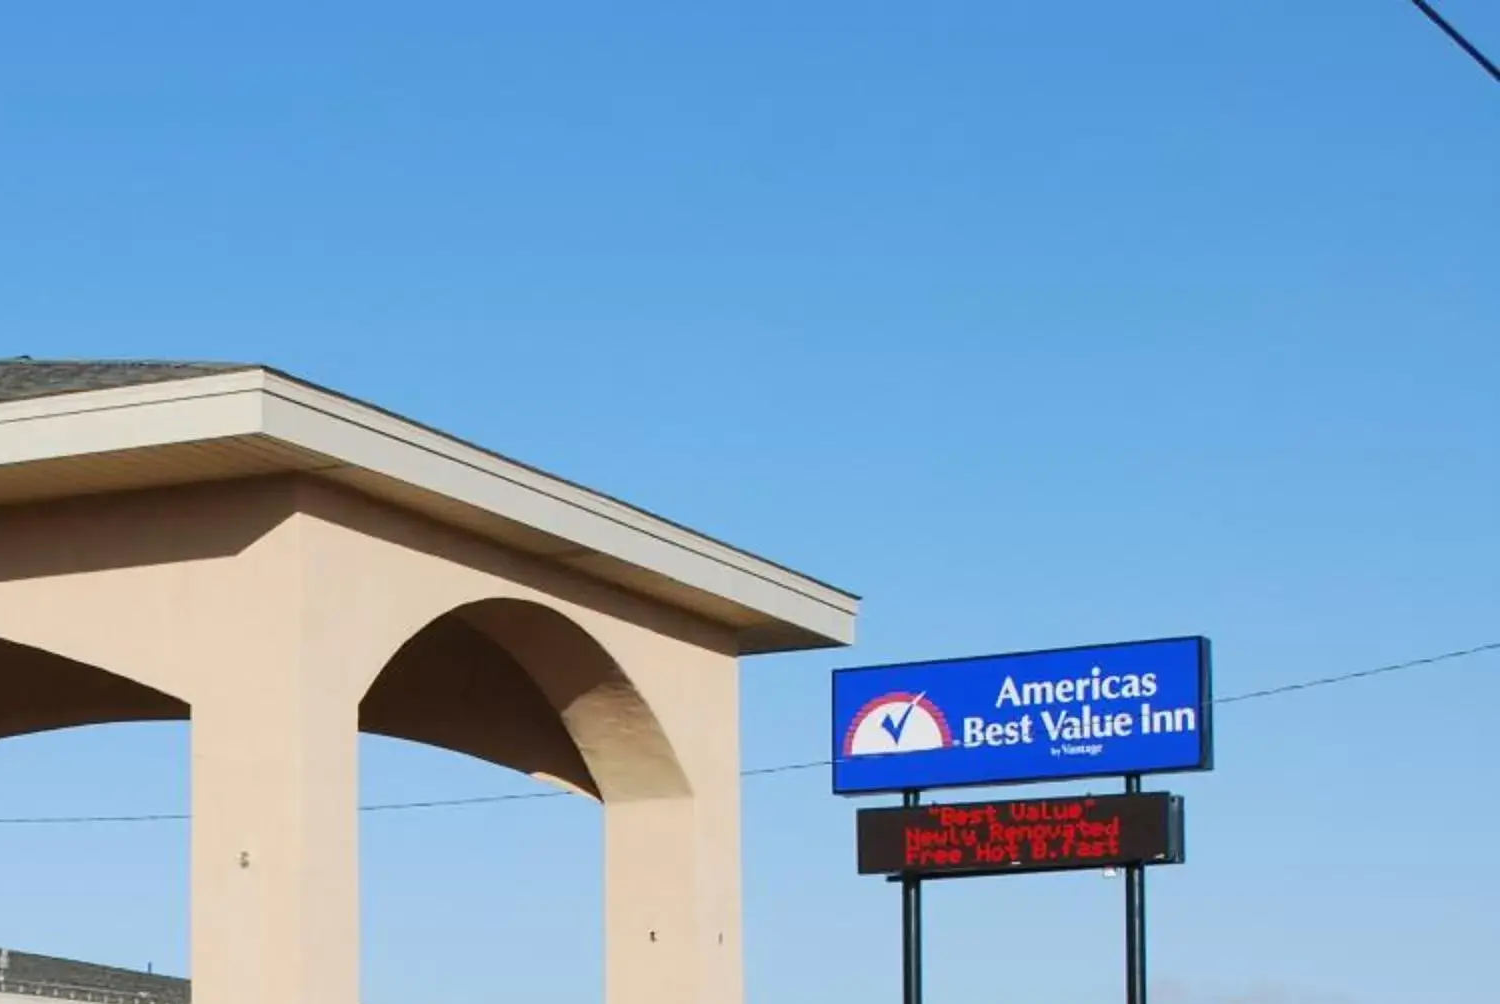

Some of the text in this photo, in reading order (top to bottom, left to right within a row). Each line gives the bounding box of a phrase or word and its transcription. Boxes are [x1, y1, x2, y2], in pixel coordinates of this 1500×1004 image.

[995, 666, 1158, 708] Americas
[963, 703, 1196, 748] Best Value Inn
[906, 816, 1119, 846] Newly Renovated
[906, 848, 963, 865] Free
[975, 844, 1019, 862] Hot
